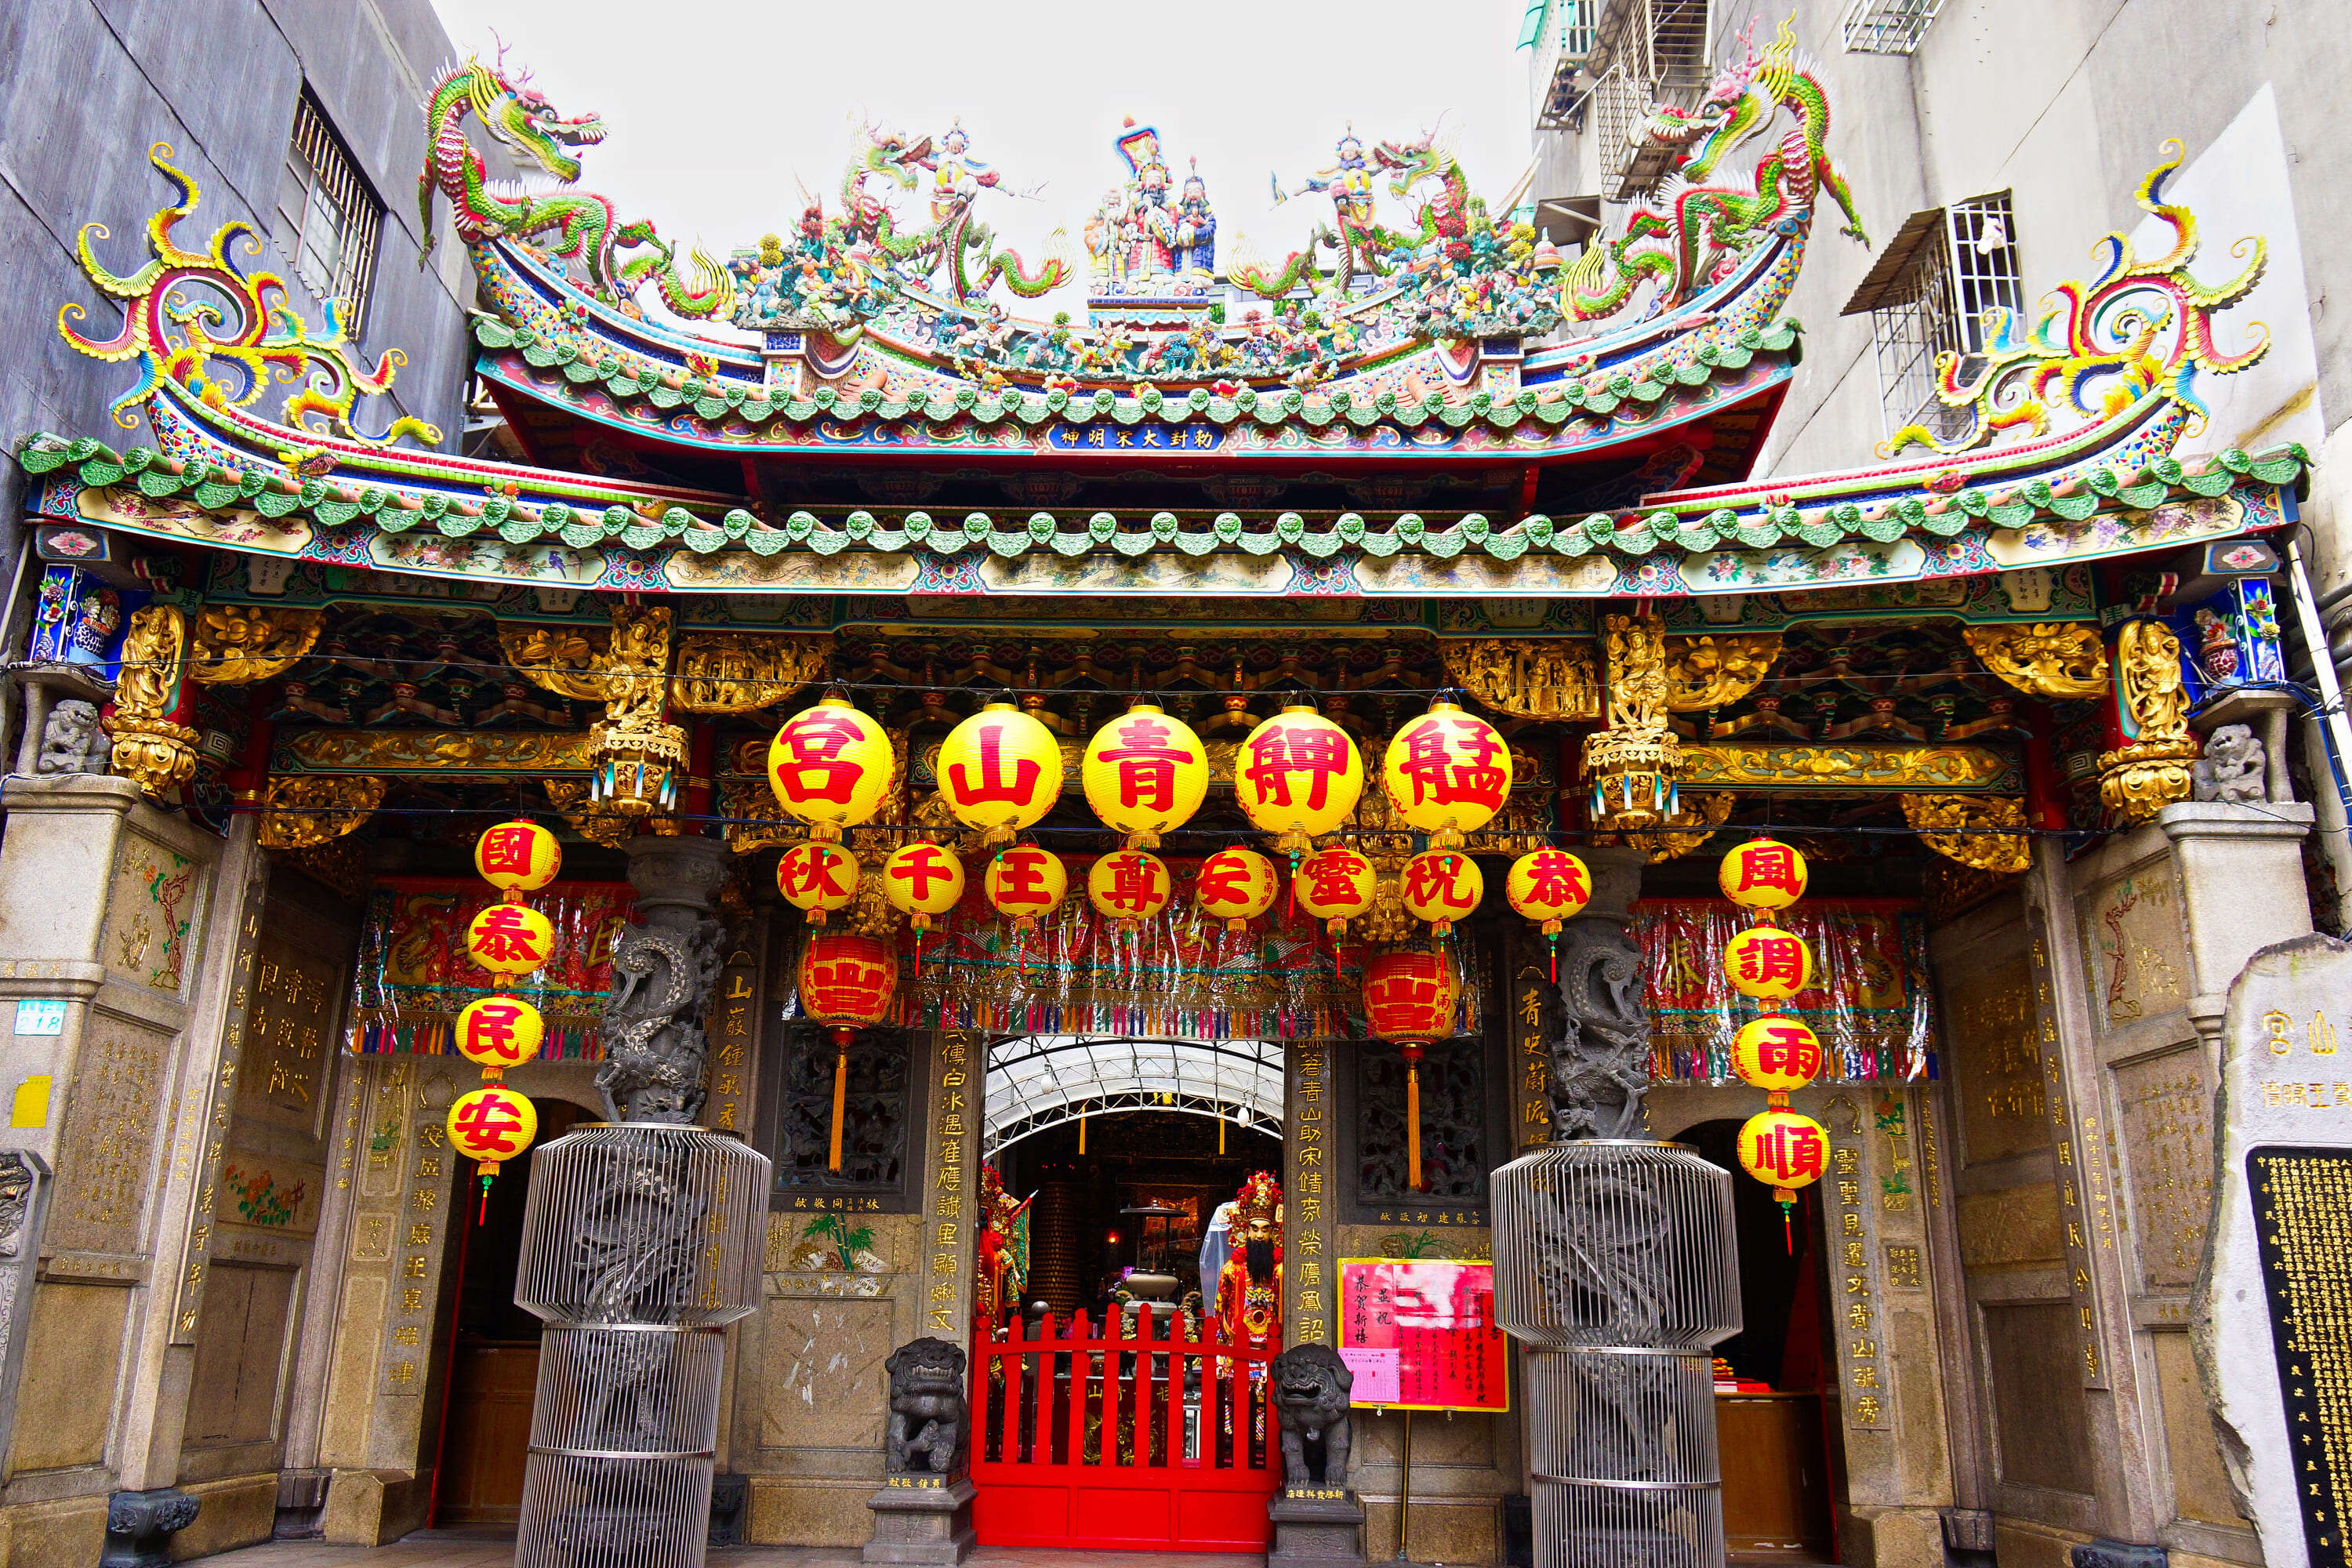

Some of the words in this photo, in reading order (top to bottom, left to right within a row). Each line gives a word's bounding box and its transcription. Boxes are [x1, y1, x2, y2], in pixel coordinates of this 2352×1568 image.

[776, 710, 865, 804] 宮
[948, 725, 1041, 807] 山
[1098, 718, 1194, 812] 青
[1245, 724, 1348, 811] 舺
[1399, 719, 1506, 813] 艋
[481, 827, 536, 877] 國
[779, 847, 848, 898] 秋
[891, 846, 953, 901] 千
[994, 851, 1052, 905] 王
[1196, 852, 1251, 905] 安
[1302, 851, 1367, 906] 靈
[1523, 851, 1589, 907] 恭
[1737, 845, 1803, 897] 風
[1102, 854, 1163, 913] 尊
[1403, 853, 1474, 909] 祝
[472, 906, 543, 962] 泰
[1737, 938, 1803, 990] 調
[465, 1004, 523, 1060] 民
[1758, 1028, 1820, 1080] 雨
[454, 1093, 523, 1153] 安
[1754, 1123, 1823, 1181] 順
[1354, 1275, 1370, 1344] 恭賀新禧
